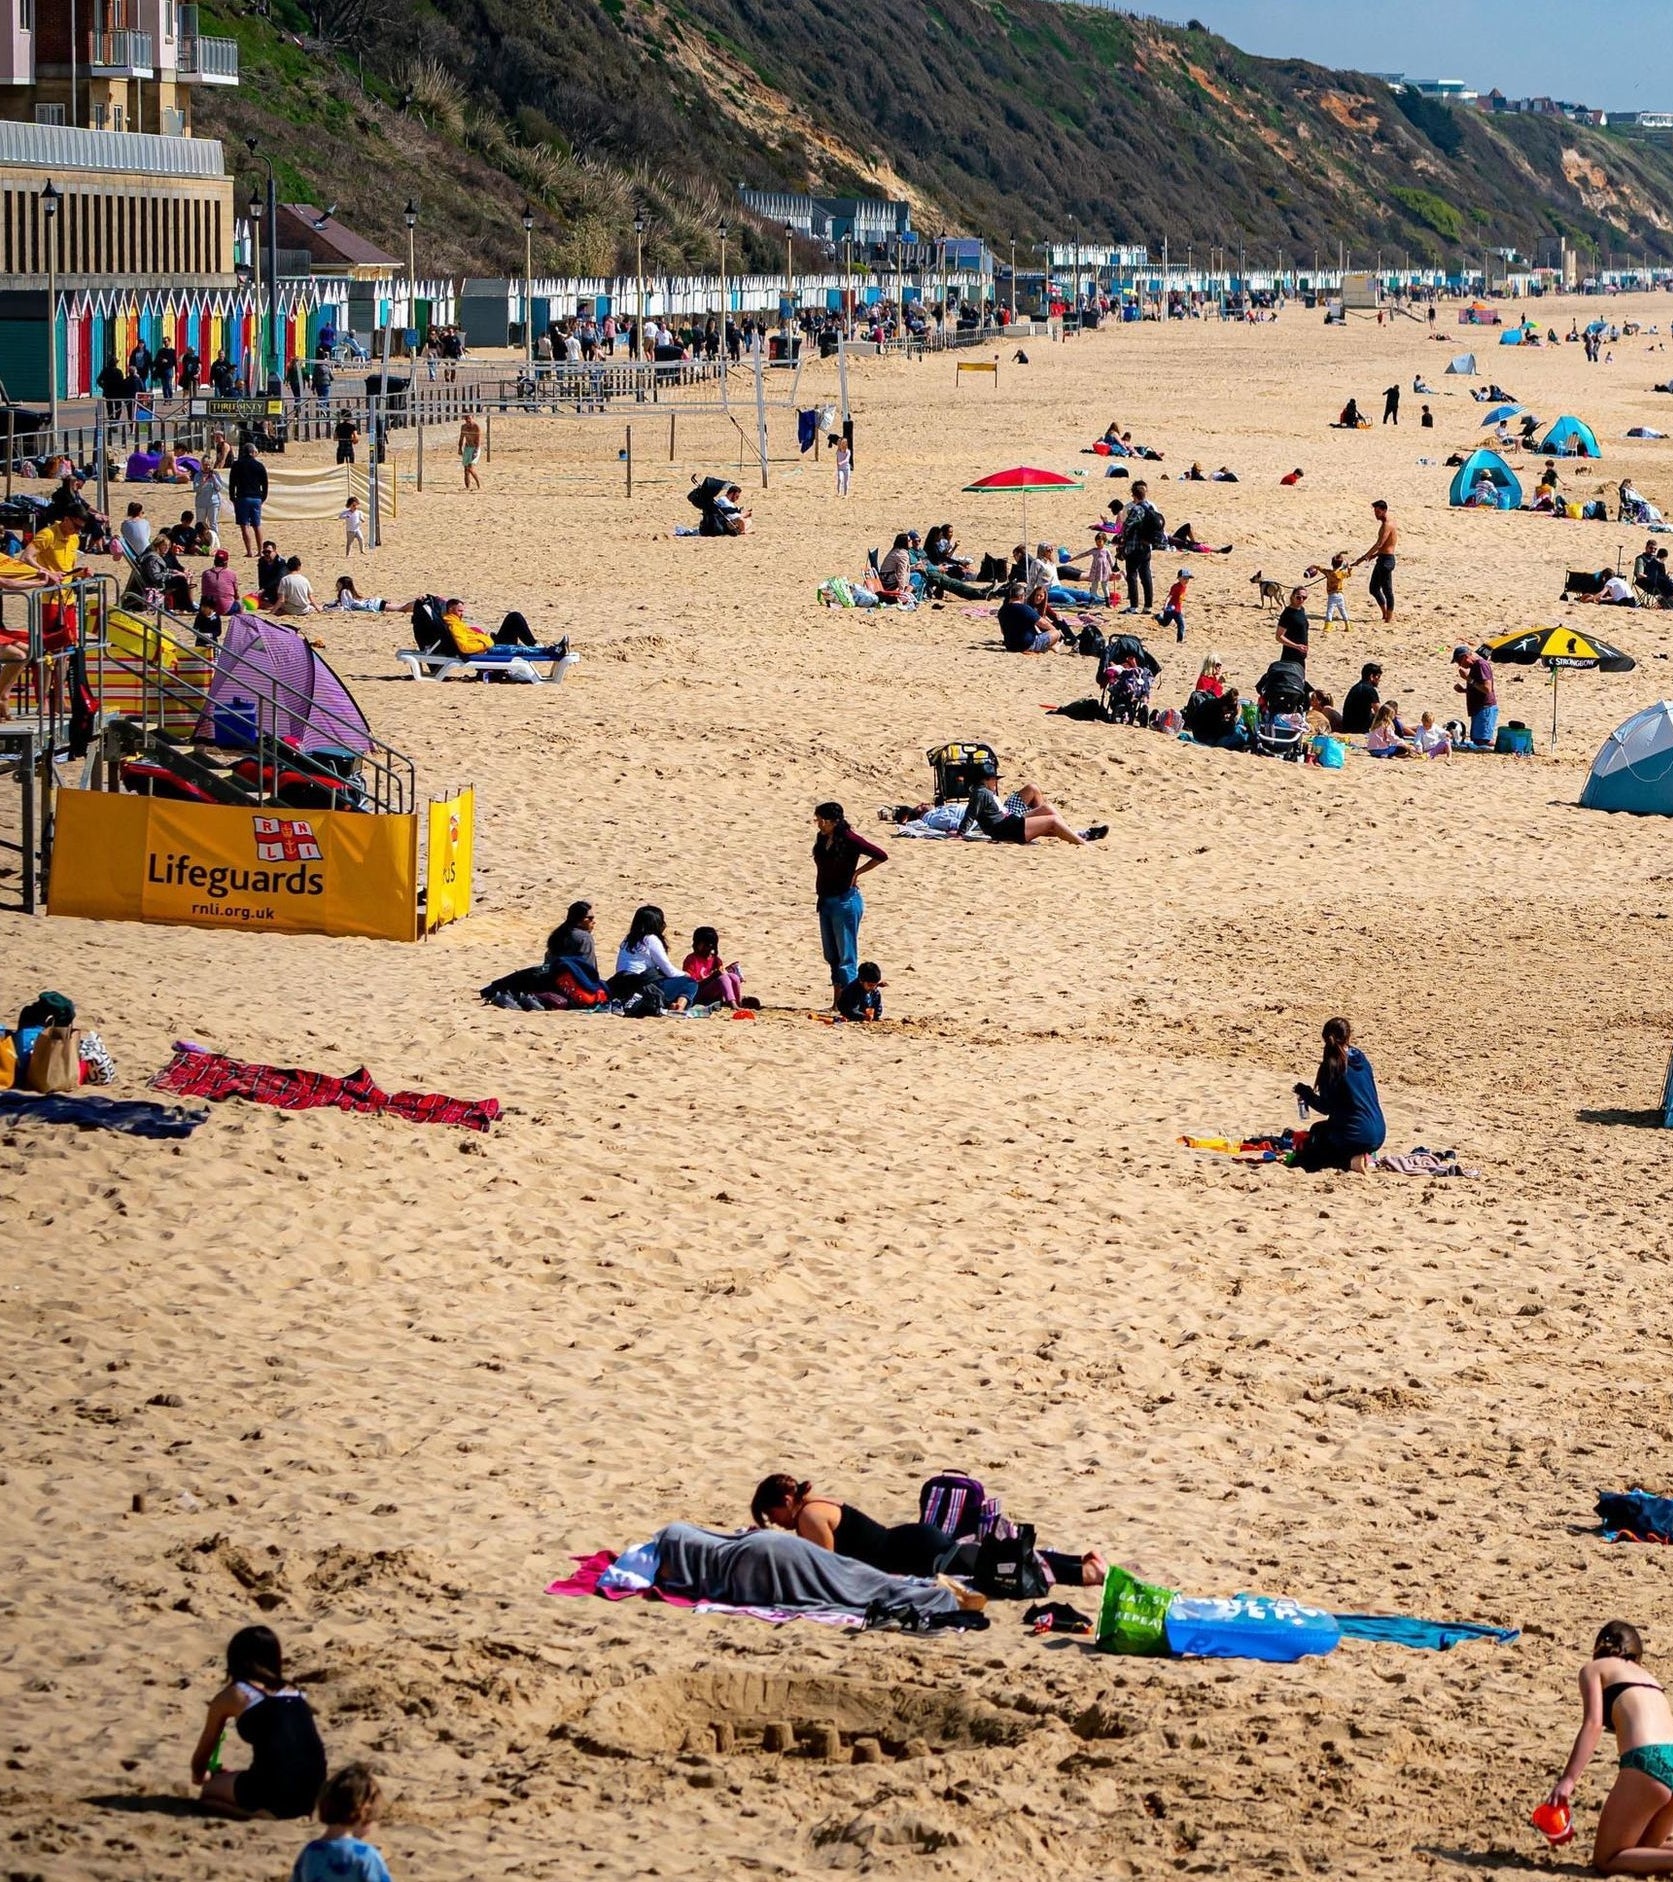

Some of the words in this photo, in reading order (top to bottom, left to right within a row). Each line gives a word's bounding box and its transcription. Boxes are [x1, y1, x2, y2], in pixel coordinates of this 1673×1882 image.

[1555, 657, 1595, 667] STRONGBOW
[147, 853, 324, 898] Lifeguards
[191, 903, 275, 920] rnli.org.uk
